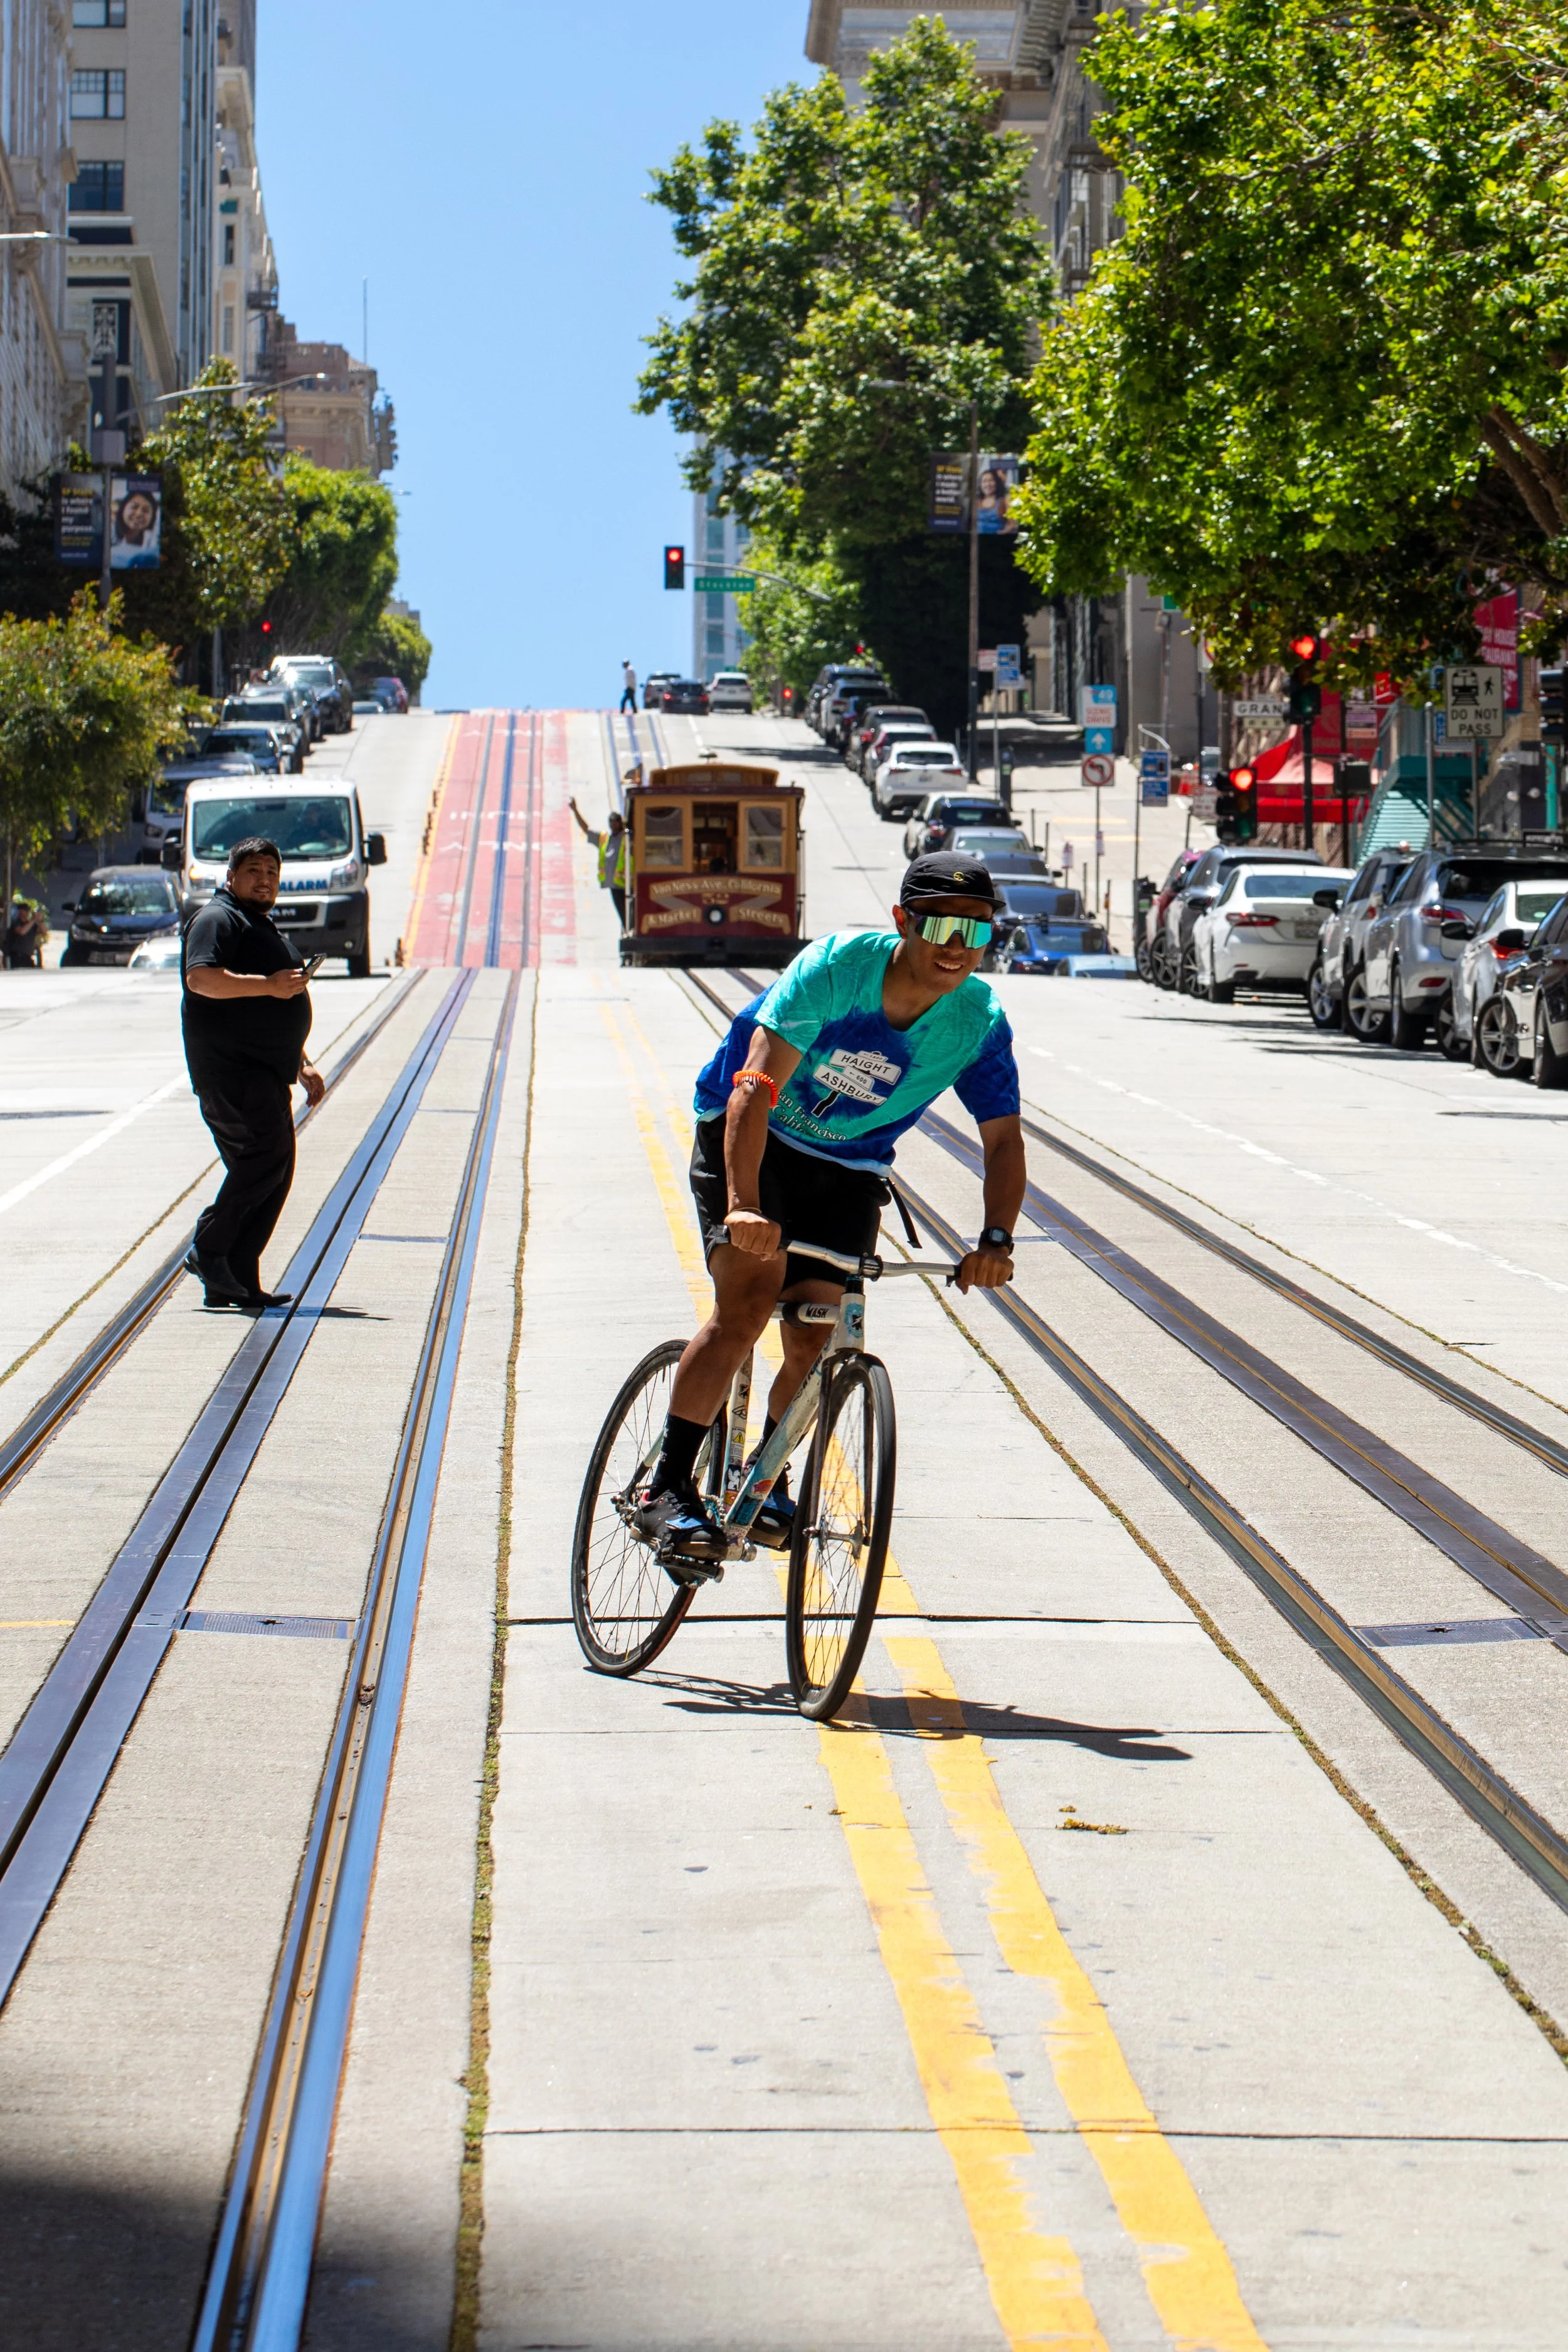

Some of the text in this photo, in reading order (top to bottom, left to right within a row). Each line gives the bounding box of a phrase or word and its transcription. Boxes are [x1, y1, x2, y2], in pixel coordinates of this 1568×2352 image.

[1237, 703, 1283, 714] GRAN
[1451, 707, 1498, 721] DO NOT
[1458, 723, 1491, 735] PASS
[652, 884, 672, 895] Van
[672, 881, 699, 892] Ness
[727, 879, 781, 894] California
[701, 893, 729, 905] 52
[659, 909, 697, 924] Market
[738, 909, 784, 924] Streets
[840, 1054, 891, 1074] HAIGHT
[856, 1074, 867, 1084] 600
[821, 1072, 881, 1102] ASHBURY
[794, 1106, 846, 1141] Francisco
